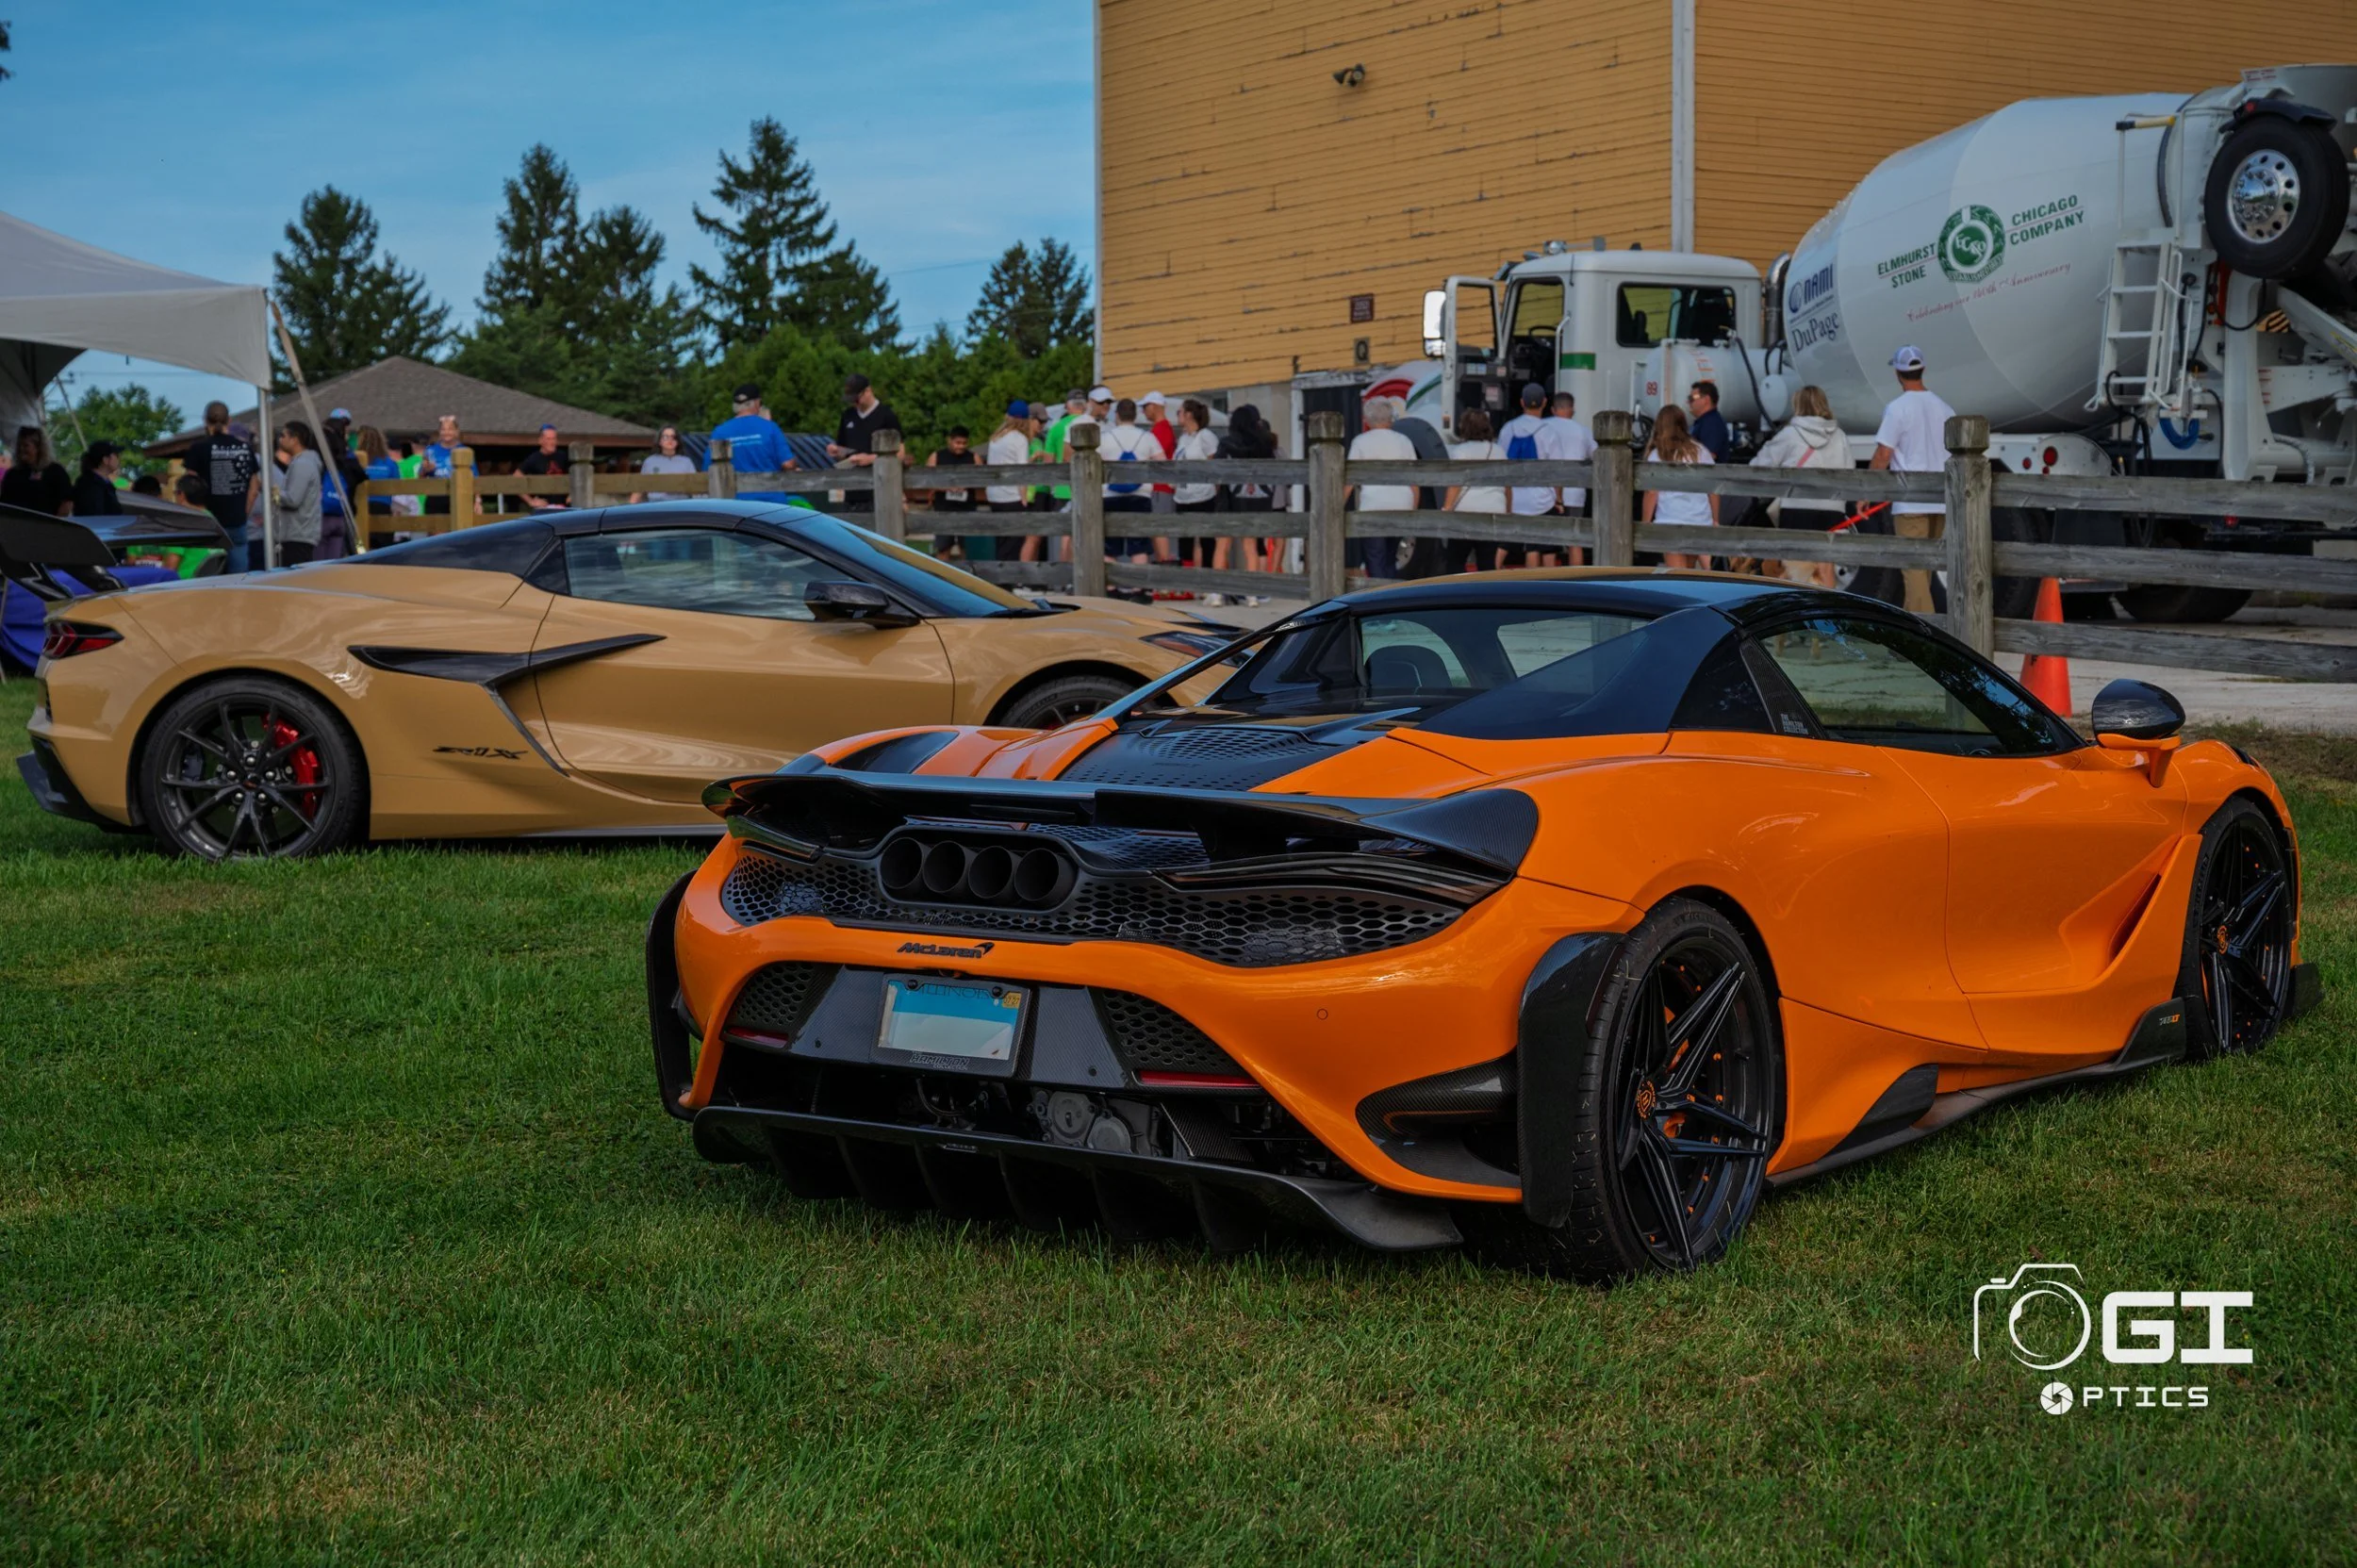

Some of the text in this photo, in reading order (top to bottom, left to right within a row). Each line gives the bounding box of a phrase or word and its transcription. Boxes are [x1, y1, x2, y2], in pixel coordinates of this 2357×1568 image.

[2012, 194, 2079, 226] CHICAGO
[2009, 210, 2085, 246] COMPANY
[1877, 242, 1937, 275] ELMHURST
[1804, 263, 1834, 305] NAMI
[1891, 265, 1926, 289] STONE
[1792, 312, 1839, 353] DuPage
[897, 942, 982, 959] McLaren
[909, 1053, 970, 1067] HAMILTON
